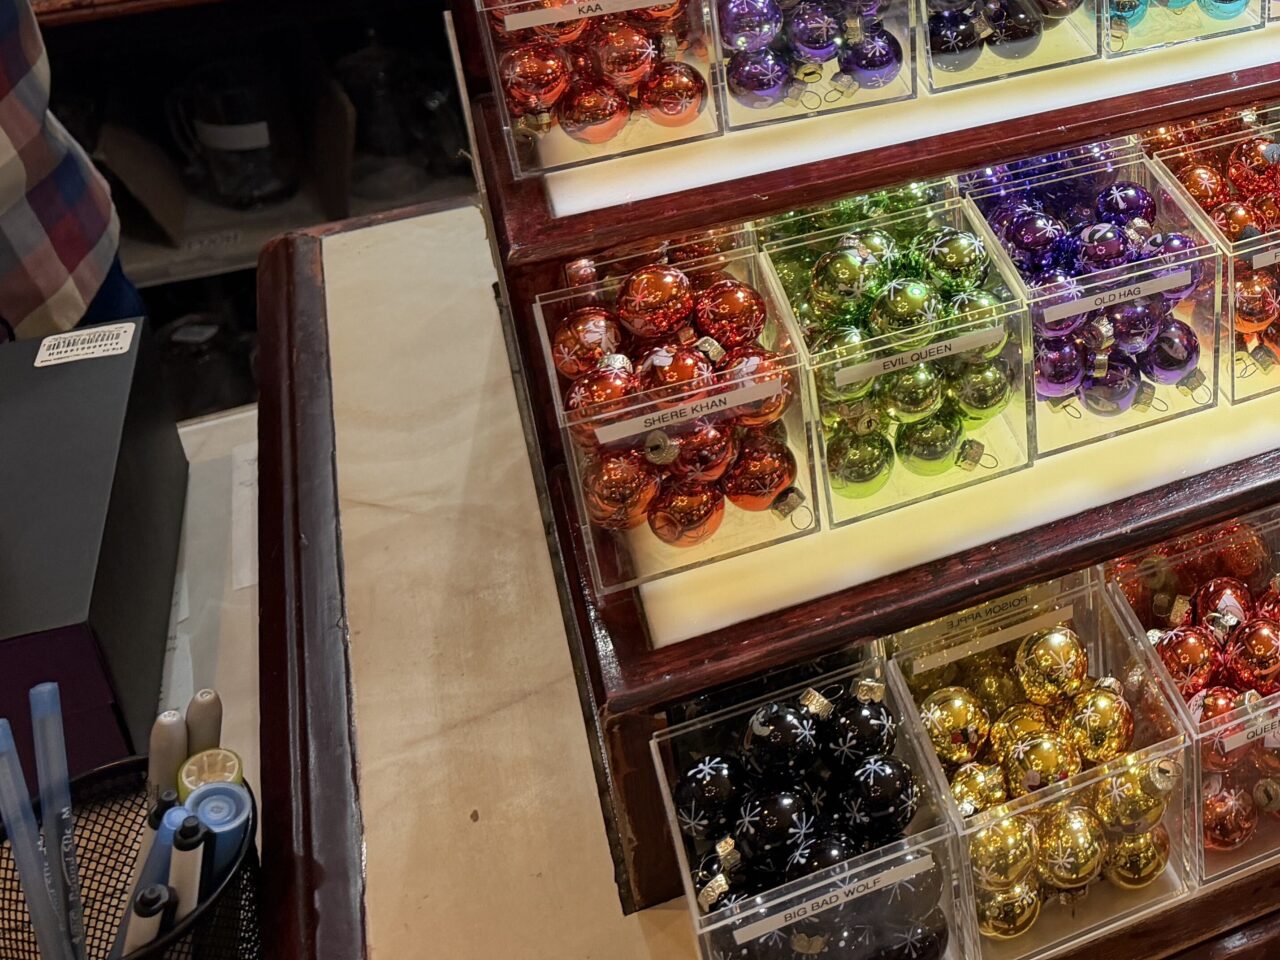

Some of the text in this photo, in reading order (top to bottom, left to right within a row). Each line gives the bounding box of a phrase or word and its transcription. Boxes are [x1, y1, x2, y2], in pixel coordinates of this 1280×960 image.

[578, 3, 603, 15] KAA
[1094, 287, 1142, 307] OLD HAG
[882, 343, 953, 371] EVIL QUEEN
[643, 396, 728, 429] SHERE KHAN
[783, 877, 882, 923] BIG BAD WOLF
